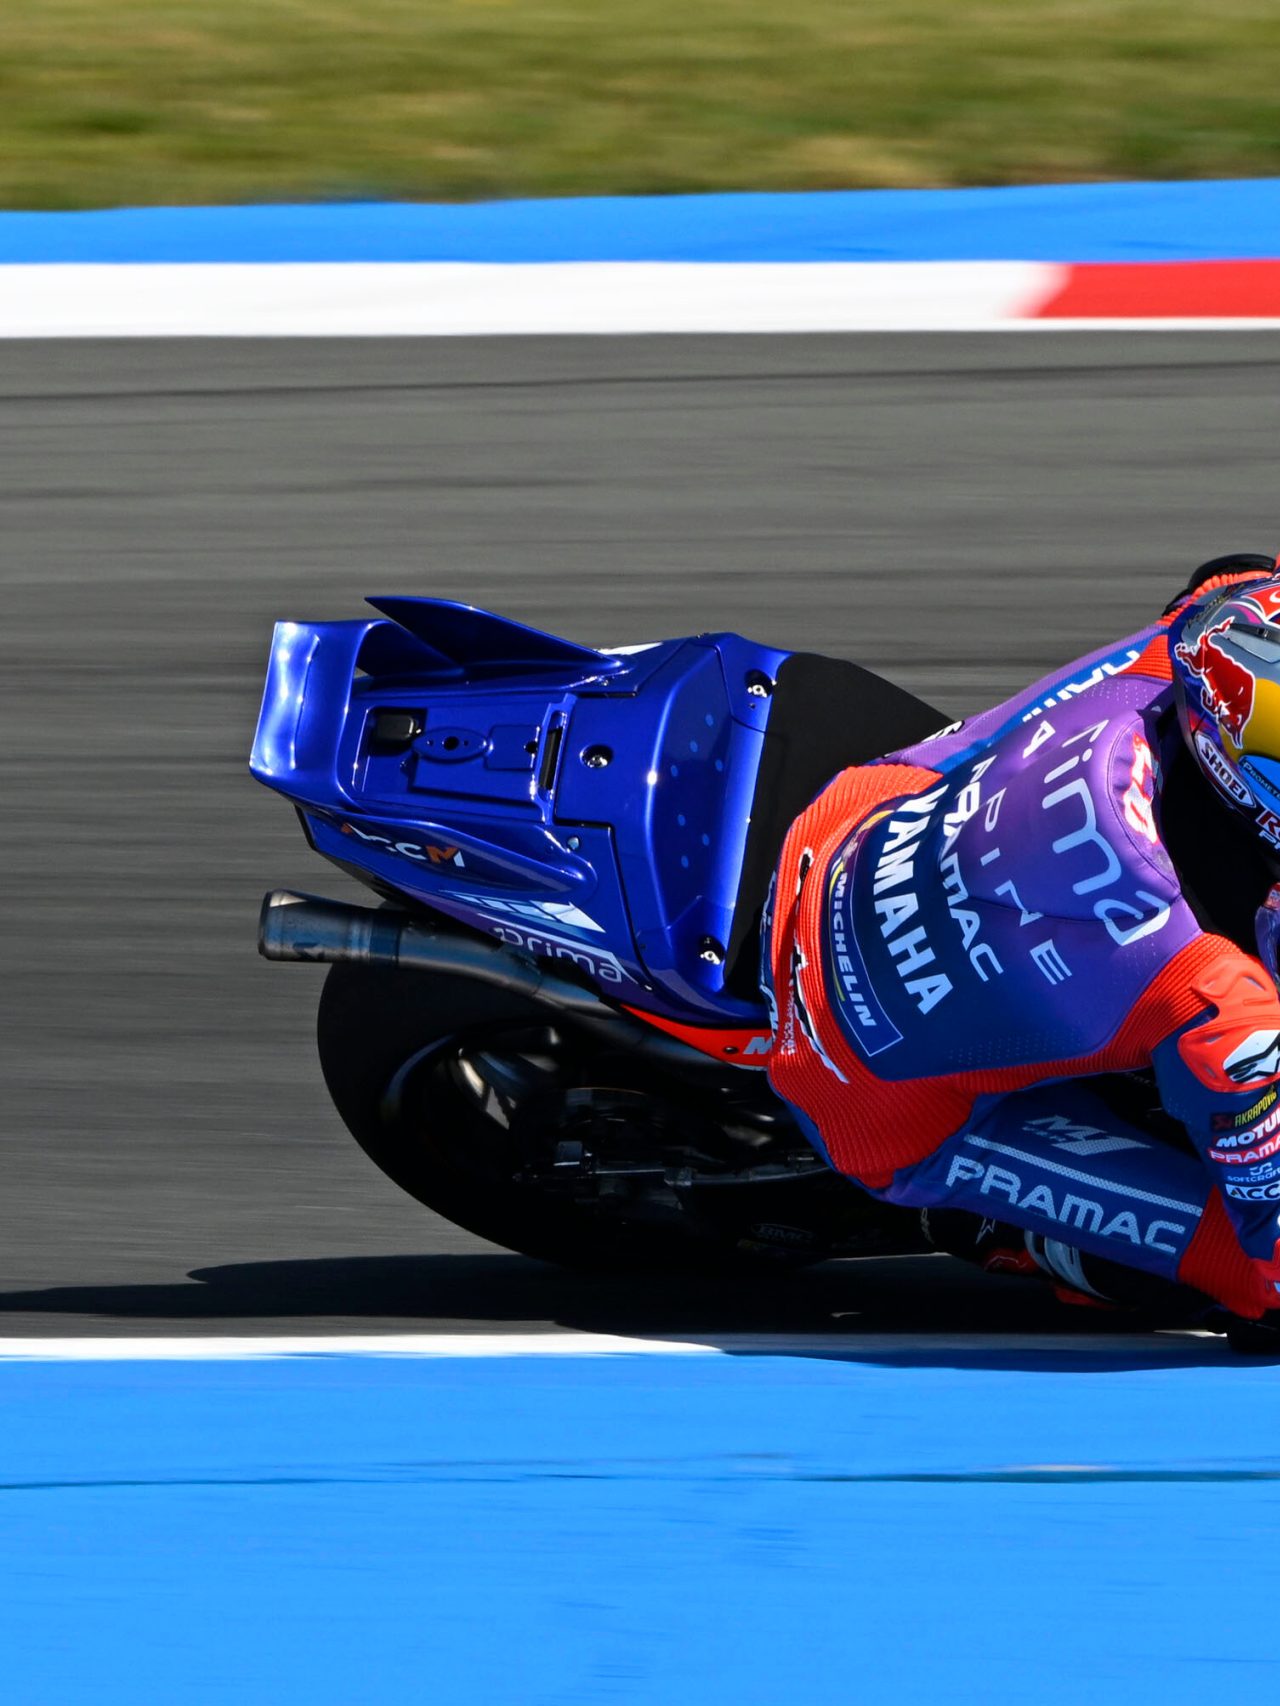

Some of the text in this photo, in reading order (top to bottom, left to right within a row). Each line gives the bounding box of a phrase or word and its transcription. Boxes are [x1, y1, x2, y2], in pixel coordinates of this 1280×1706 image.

[1042, 719, 1171, 945] rima
[1201, 742, 1247, 801] SHOEI
[493, 928, 623, 983] prima
[834, 872, 877, 1026] MICHELIN
[873, 784, 954, 1015] YAMAHA
[946, 1155, 1186, 1254] PRAMAC
